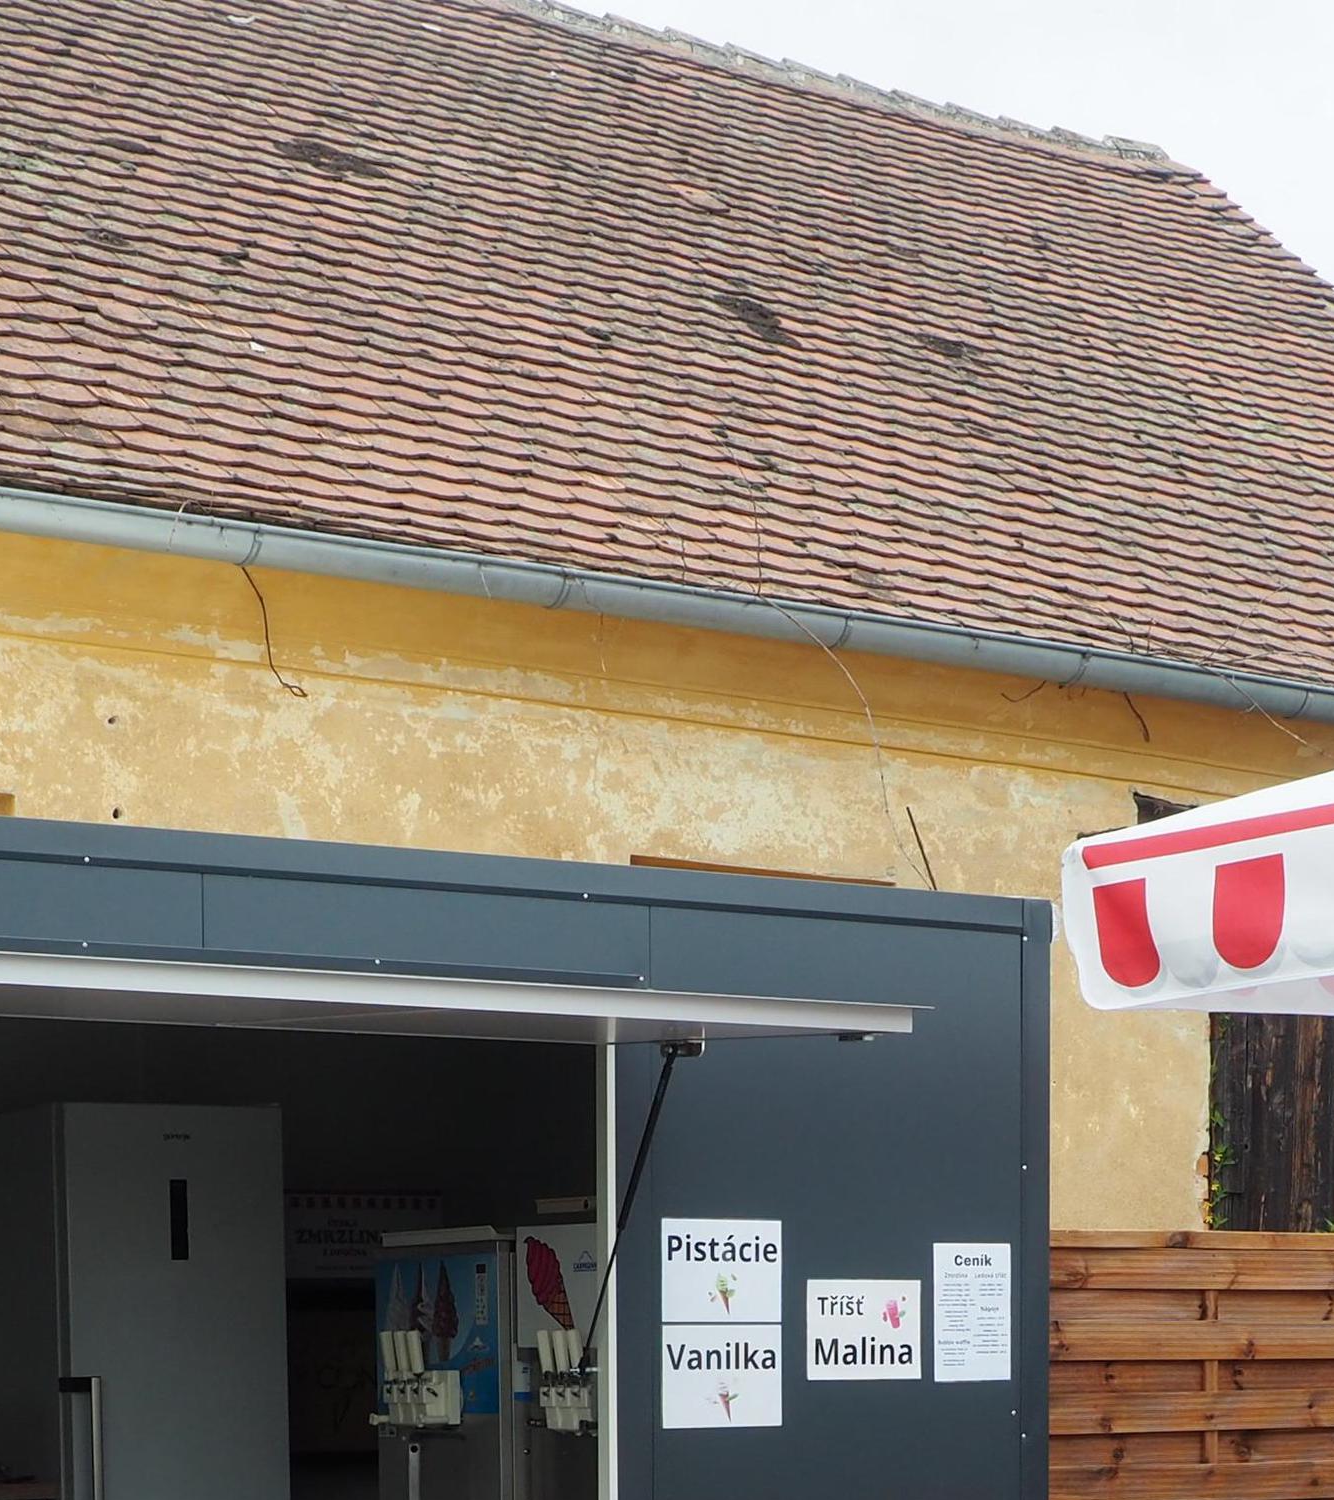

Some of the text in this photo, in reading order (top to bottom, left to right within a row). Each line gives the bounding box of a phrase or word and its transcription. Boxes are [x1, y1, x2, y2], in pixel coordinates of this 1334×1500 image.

[667, 1234, 778, 1263] Pistácie
[954, 1254, 992, 1267] Ceník
[817, 1295, 865, 1316] Tříšť
[667, 1342, 777, 1371] Vanilka
[814, 1336, 914, 1366] Malina
